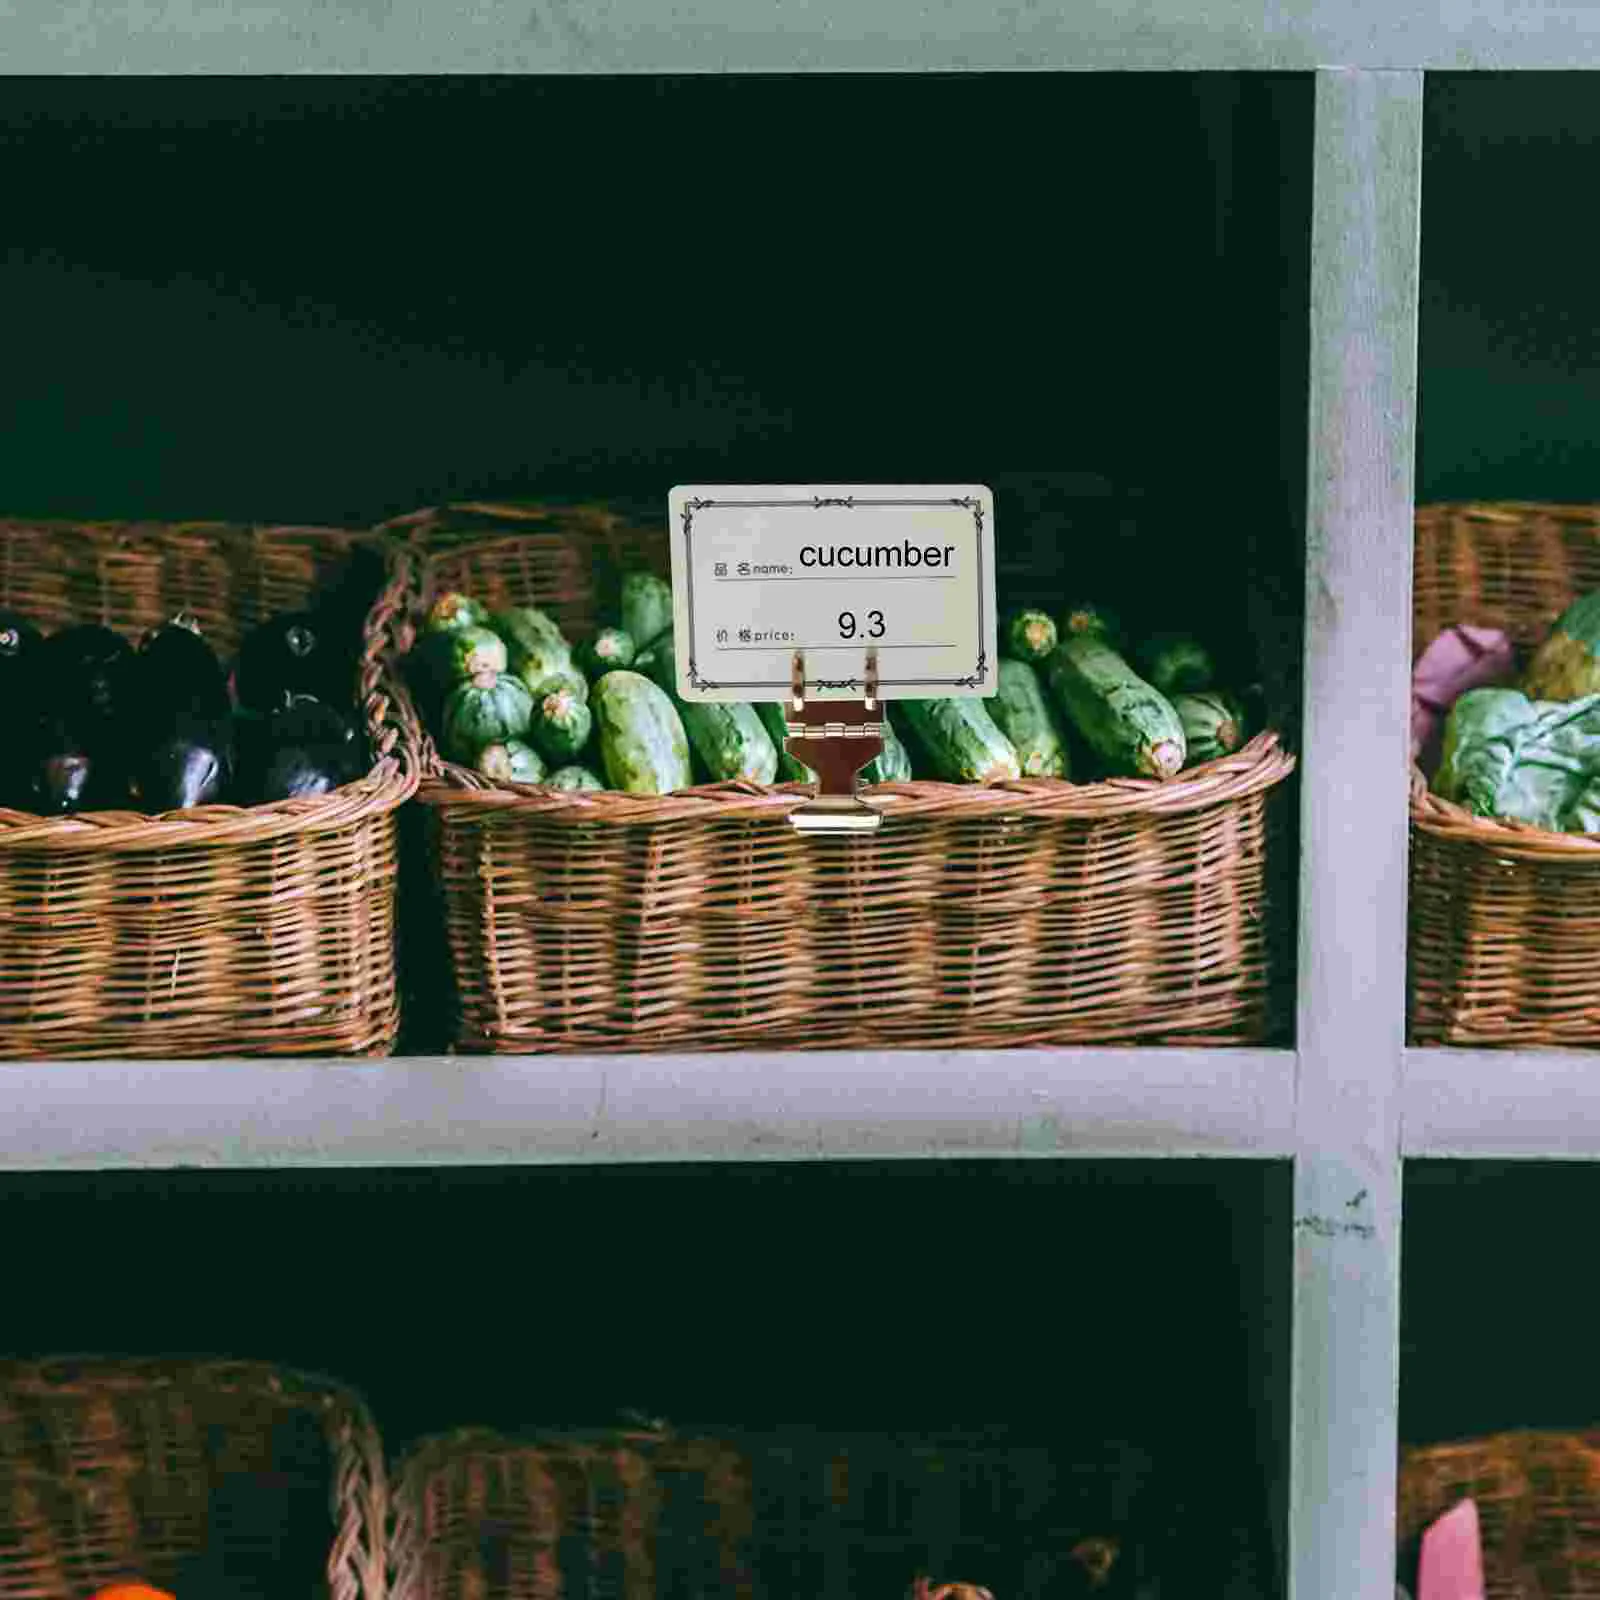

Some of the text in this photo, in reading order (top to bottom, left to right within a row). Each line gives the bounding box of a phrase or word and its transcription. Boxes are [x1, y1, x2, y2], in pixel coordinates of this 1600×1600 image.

[799, 539, 956, 568] cucumber
[754, 628, 795, 643] price:
[837, 610, 886, 640] 9.3
